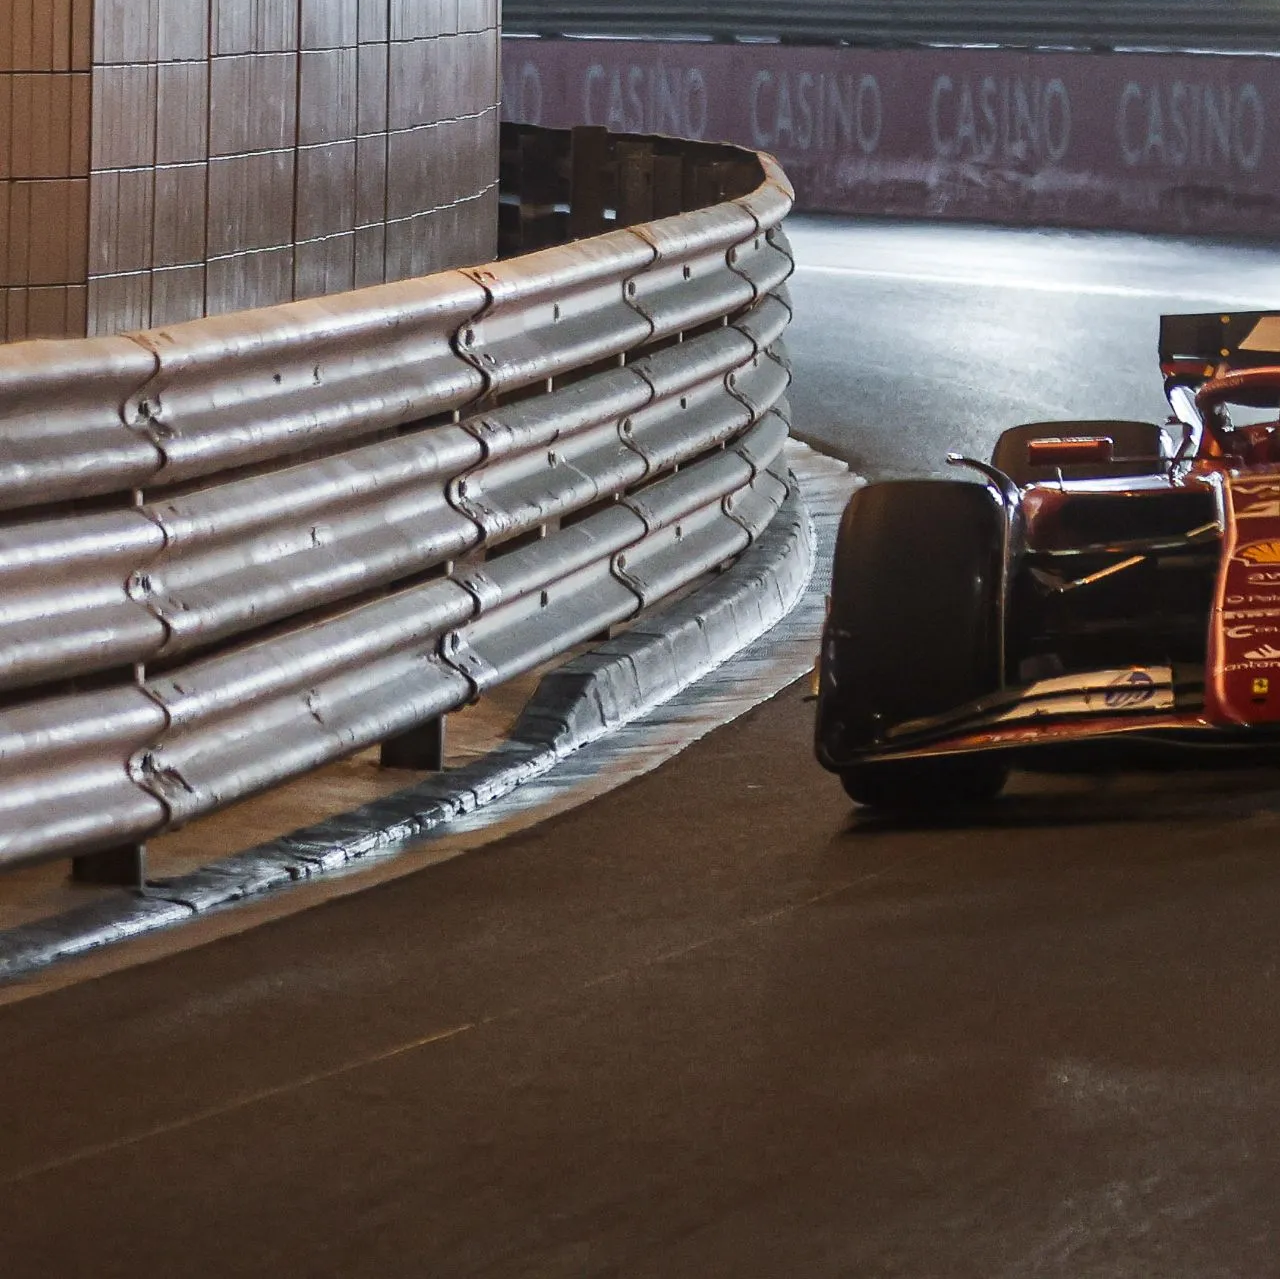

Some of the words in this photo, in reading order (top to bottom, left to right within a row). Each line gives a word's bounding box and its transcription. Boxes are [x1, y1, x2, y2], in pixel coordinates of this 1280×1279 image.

[585, 62, 707, 140] CASINO
[751, 69, 880, 153] CASINO
[930, 74, 1071, 161] CASINO
[1115, 80, 1263, 170] CASINO
